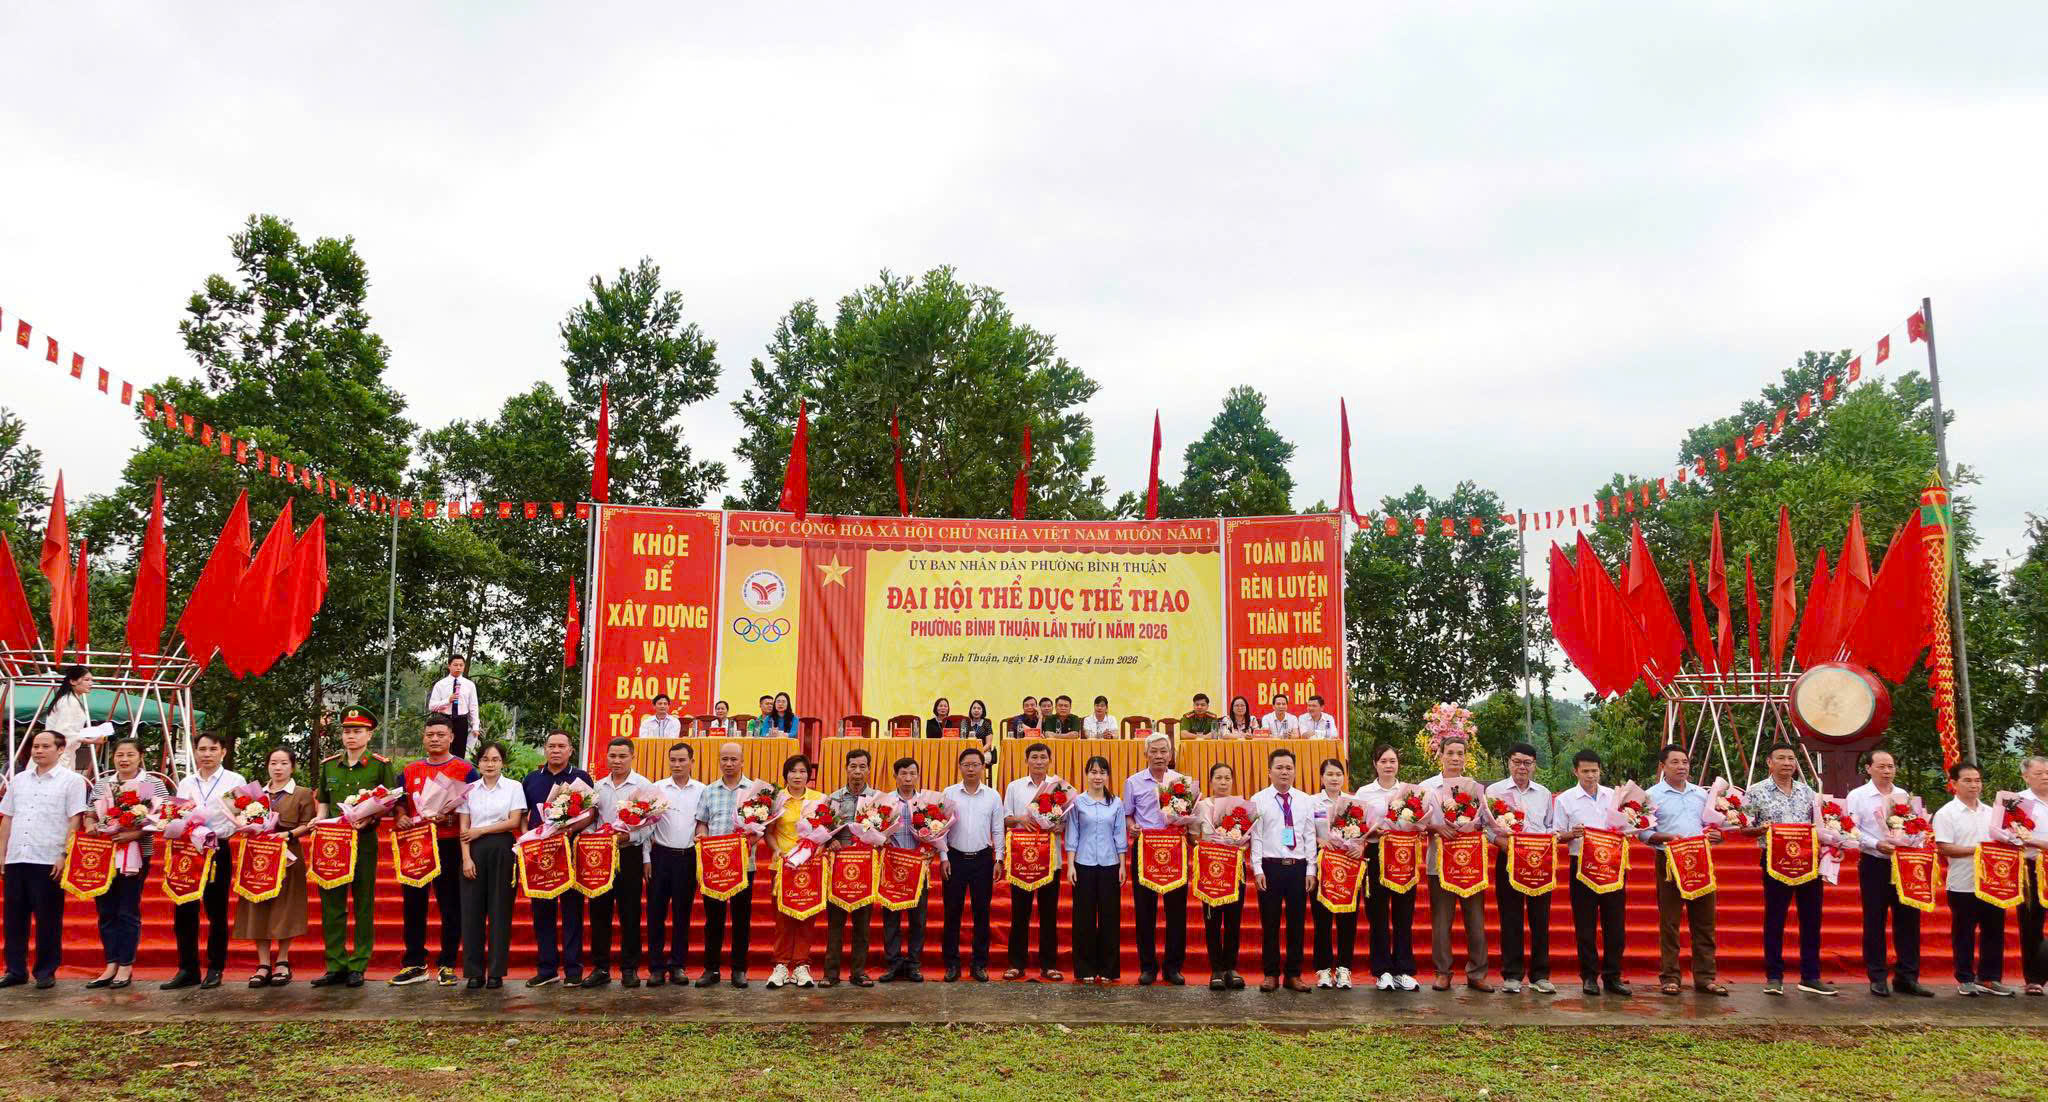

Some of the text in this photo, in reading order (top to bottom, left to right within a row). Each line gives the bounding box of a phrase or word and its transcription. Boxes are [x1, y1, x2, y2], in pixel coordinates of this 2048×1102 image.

[632, 525, 689, 557] KHỎE
[738, 519, 785, 533] NƯỚC
[790, 519, 836, 536] CỘNG
[840, 521, 873, 537] HÒA
[878, 523, 899, 537] XÃ
[904, 523, 933, 541] HỘI
[938, 523, 972, 539] CHỦ
[976, 525, 1028, 540] NGHĨA
[1031, 524, 1071, 542] VIỆT
[1074, 528, 1110, 540] NAM
[1114, 524, 1162, 541] MUÔN
[1167, 524, 1202, 540] NĂM
[909, 555, 1167, 576] ỦY BAN NHÂN DÂN PHƯỜNG BÌNH THUẬN
[1243, 536, 1325, 565] TOÀN DÂN
[644, 560, 675, 592] ĐỂ
[1240, 570, 1328, 603] RÈN LUYỆN
[887, 574, 1190, 614] ĐẠI HỘI THỂ DỤC THỂ THAO
[607, 599, 708, 632] XÂY DỰNG
[911, 616, 1168, 641] PHƯỜNG BÌNH THUẬN LẦN THỨ I NĂM 2026
[1248, 602, 1323, 634] THÂN THỂ
[643, 637, 669, 664] VÀ
[941, 652, 964, 663] Bình
[966, 652, 1000, 664] Thuận,
[1002, 653, 1026, 665] ngày
[1056, 654, 1084, 666] tháng
[1085, 656, 1092, 665] 4
[1094, 655, 1115, 666] năm
[1116, 656, 1138, 665] 2026
[1239, 645, 1332, 671] THEO GƯƠNG
[616, 667, 691, 705] BẢO VỆ
[1258, 675, 1316, 705] BÁC HỒ
[609, 704, 636, 737] TỔ
